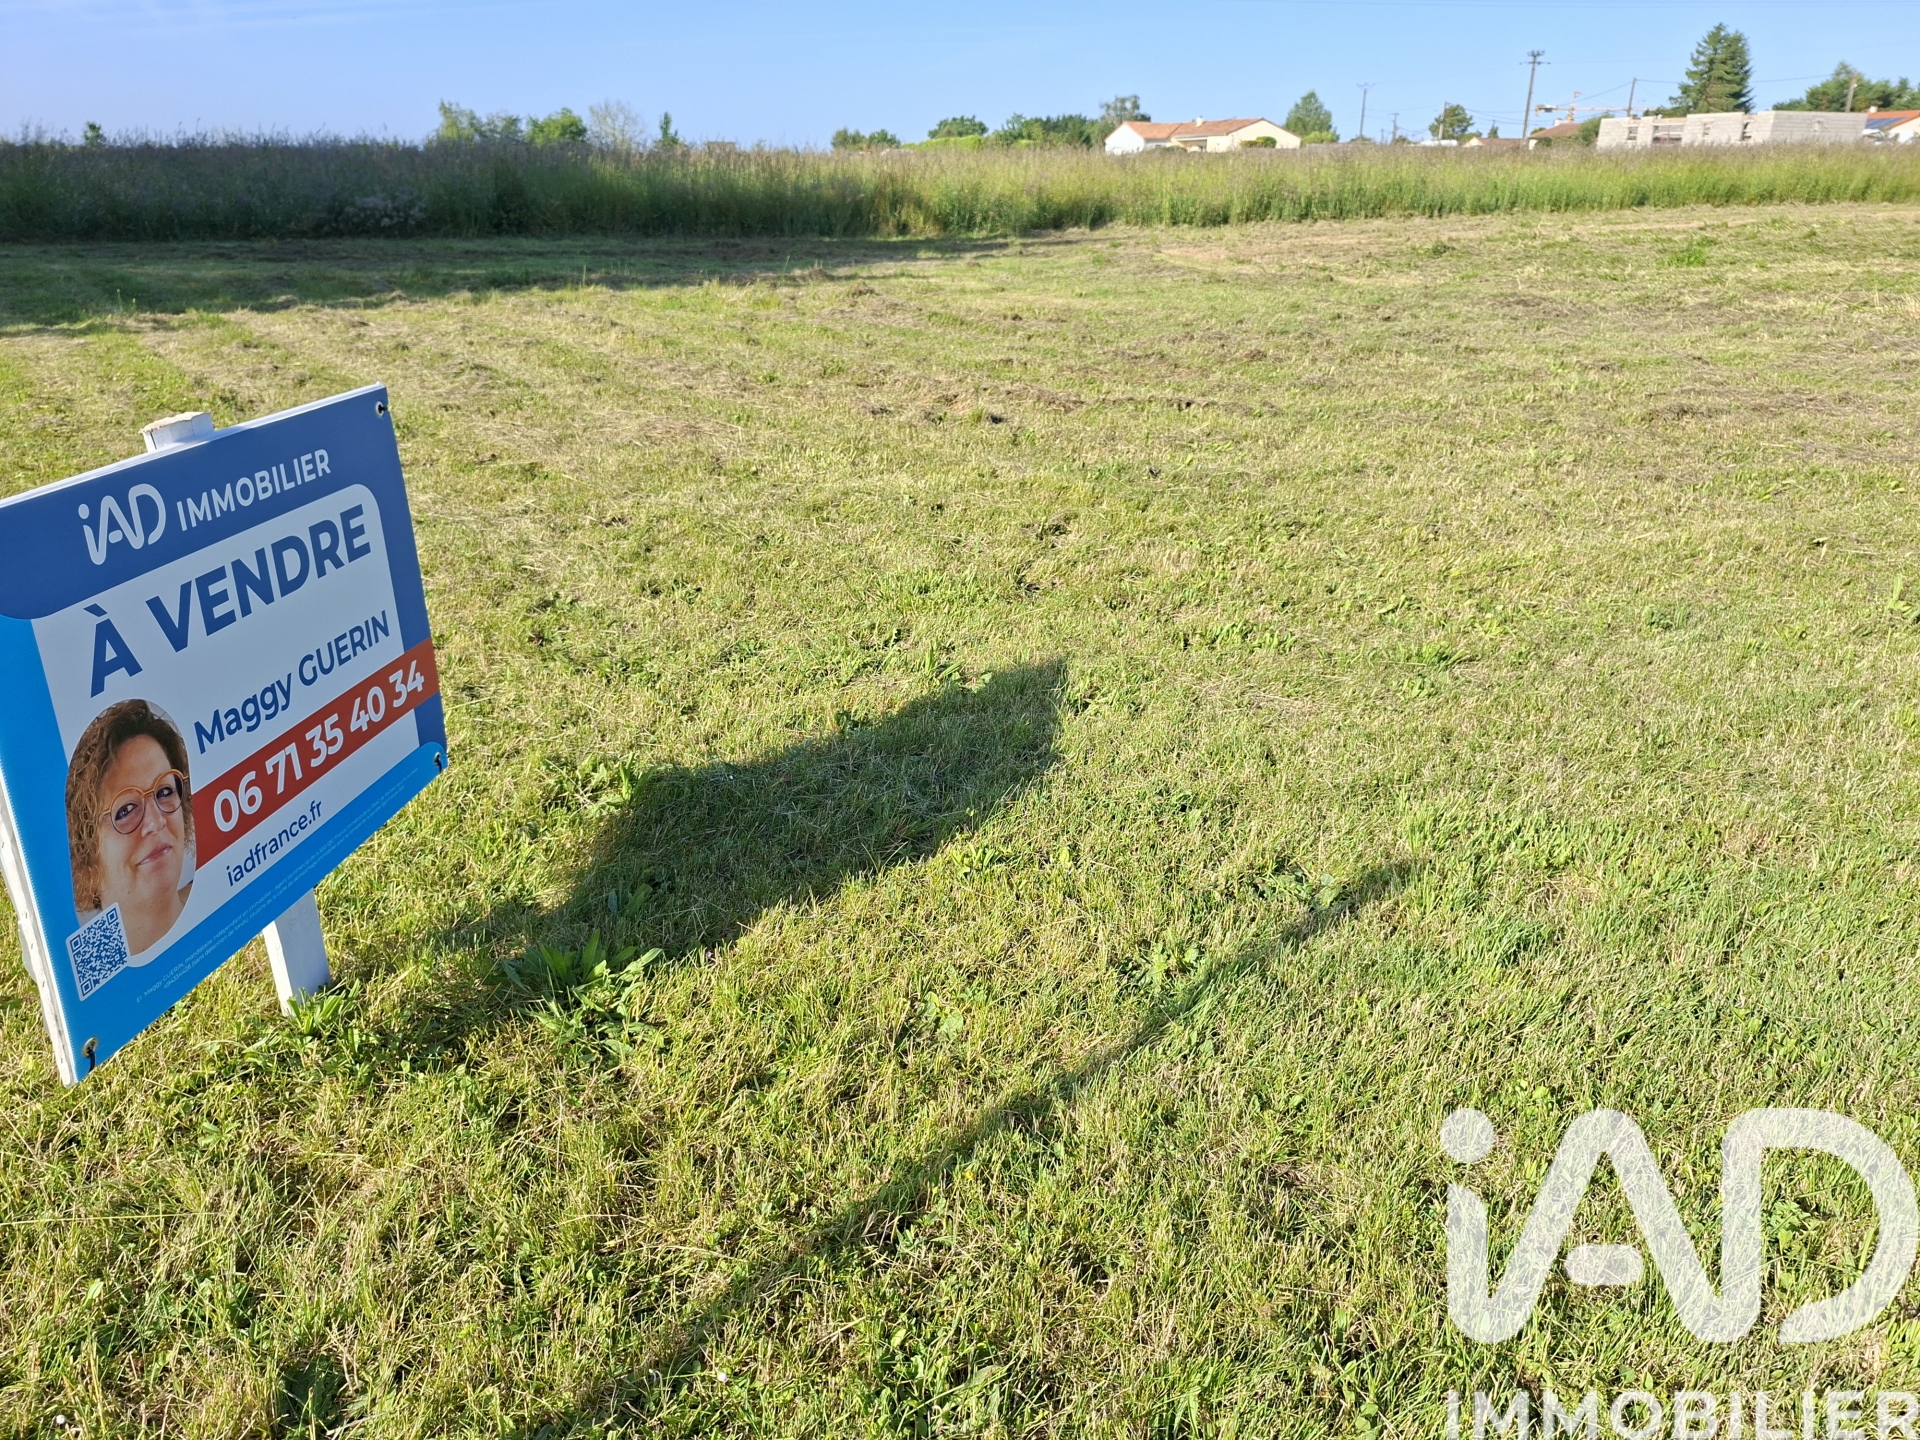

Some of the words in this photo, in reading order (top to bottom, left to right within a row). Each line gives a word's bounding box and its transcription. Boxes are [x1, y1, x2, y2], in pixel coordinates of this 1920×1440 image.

[177, 449, 331, 531] IMMOBILIER
[83, 603, 143, 699] À
[146, 504, 371, 653] VENDRE
[194, 672, 292, 754] Maggy
[298, 610, 390, 686] GUERIN
[213, 771, 263, 832] 06
[265, 742, 303, 795] 71
[305, 713, 344, 768] 35
[350, 686, 386, 732] 40
[389, 660, 425, 708] 34
[226, 800, 322, 887] iadfrance.fr
